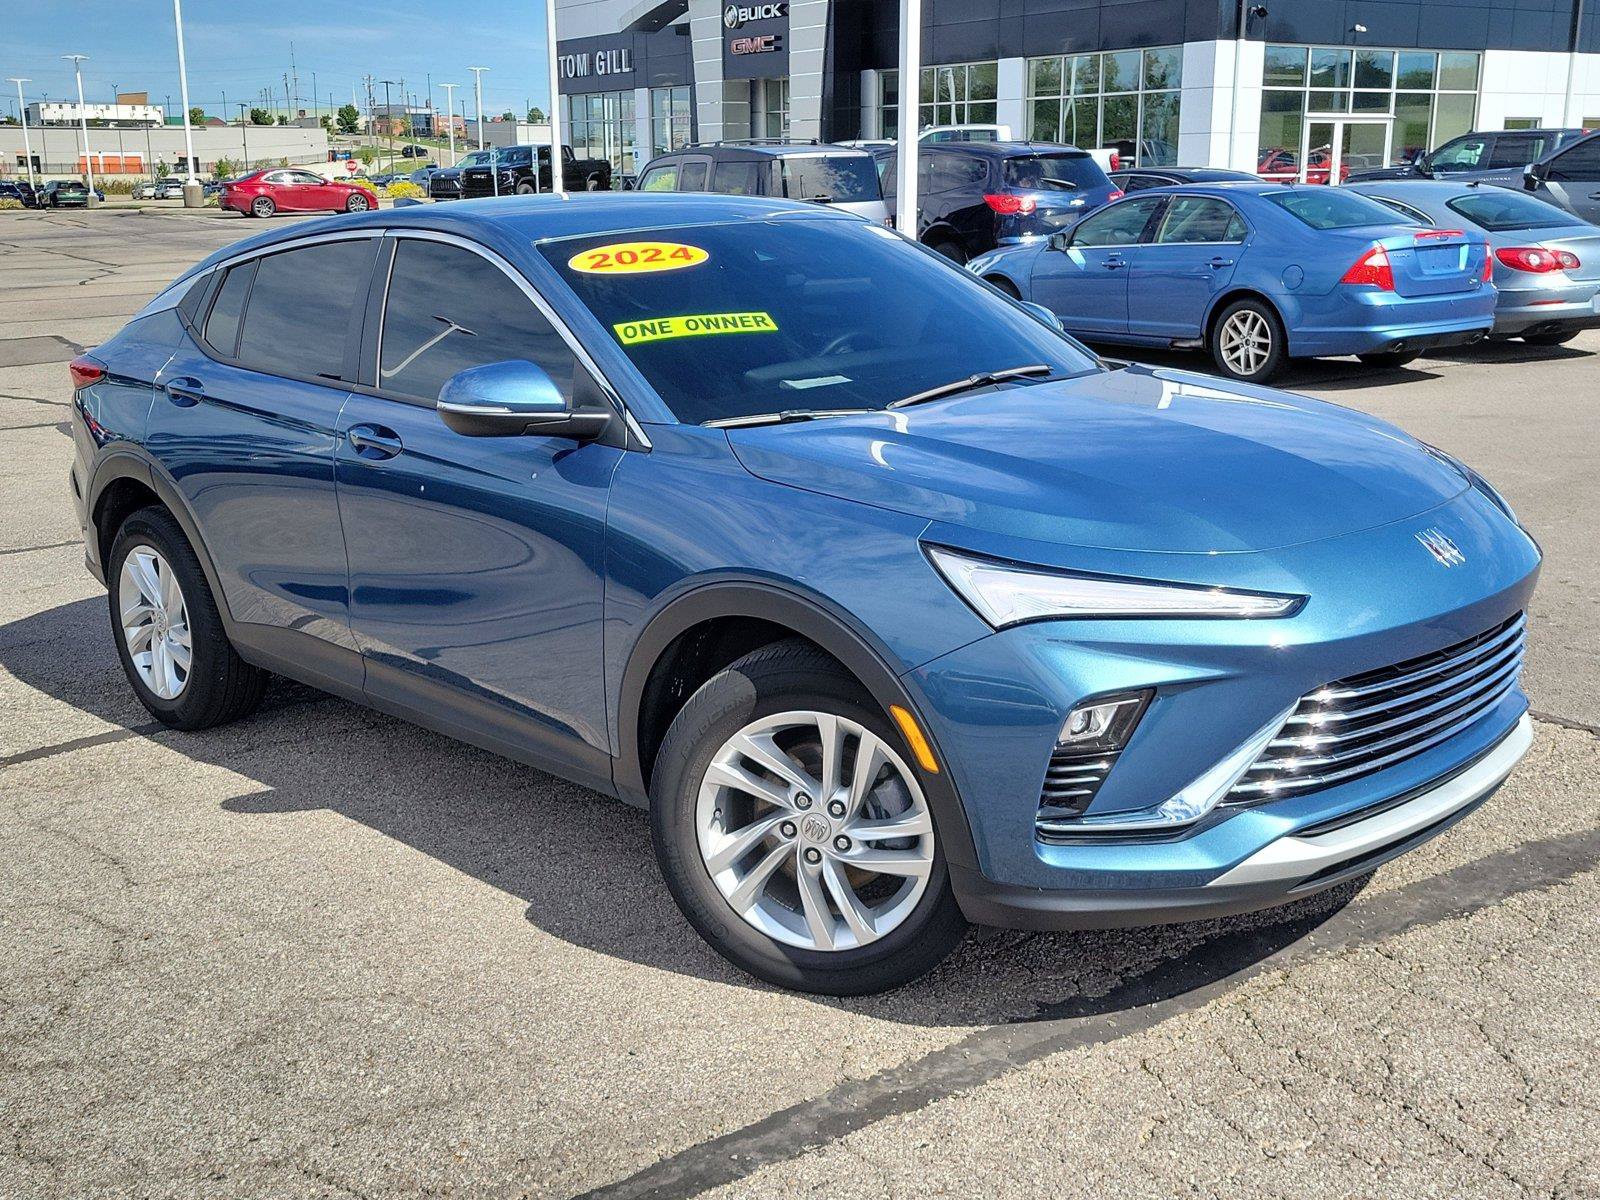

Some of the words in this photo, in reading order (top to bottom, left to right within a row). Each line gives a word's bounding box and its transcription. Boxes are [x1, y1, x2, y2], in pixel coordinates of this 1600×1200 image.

[738, 3, 782, 23] BUICK
[731, 35, 775, 55] GMC
[558, 53, 588, 78] TOM
[595, 48, 632, 76] GILL
[588, 247, 693, 269] 2024
[623, 320, 673, 339] ONE
[685, 315, 771, 332] OWNER
